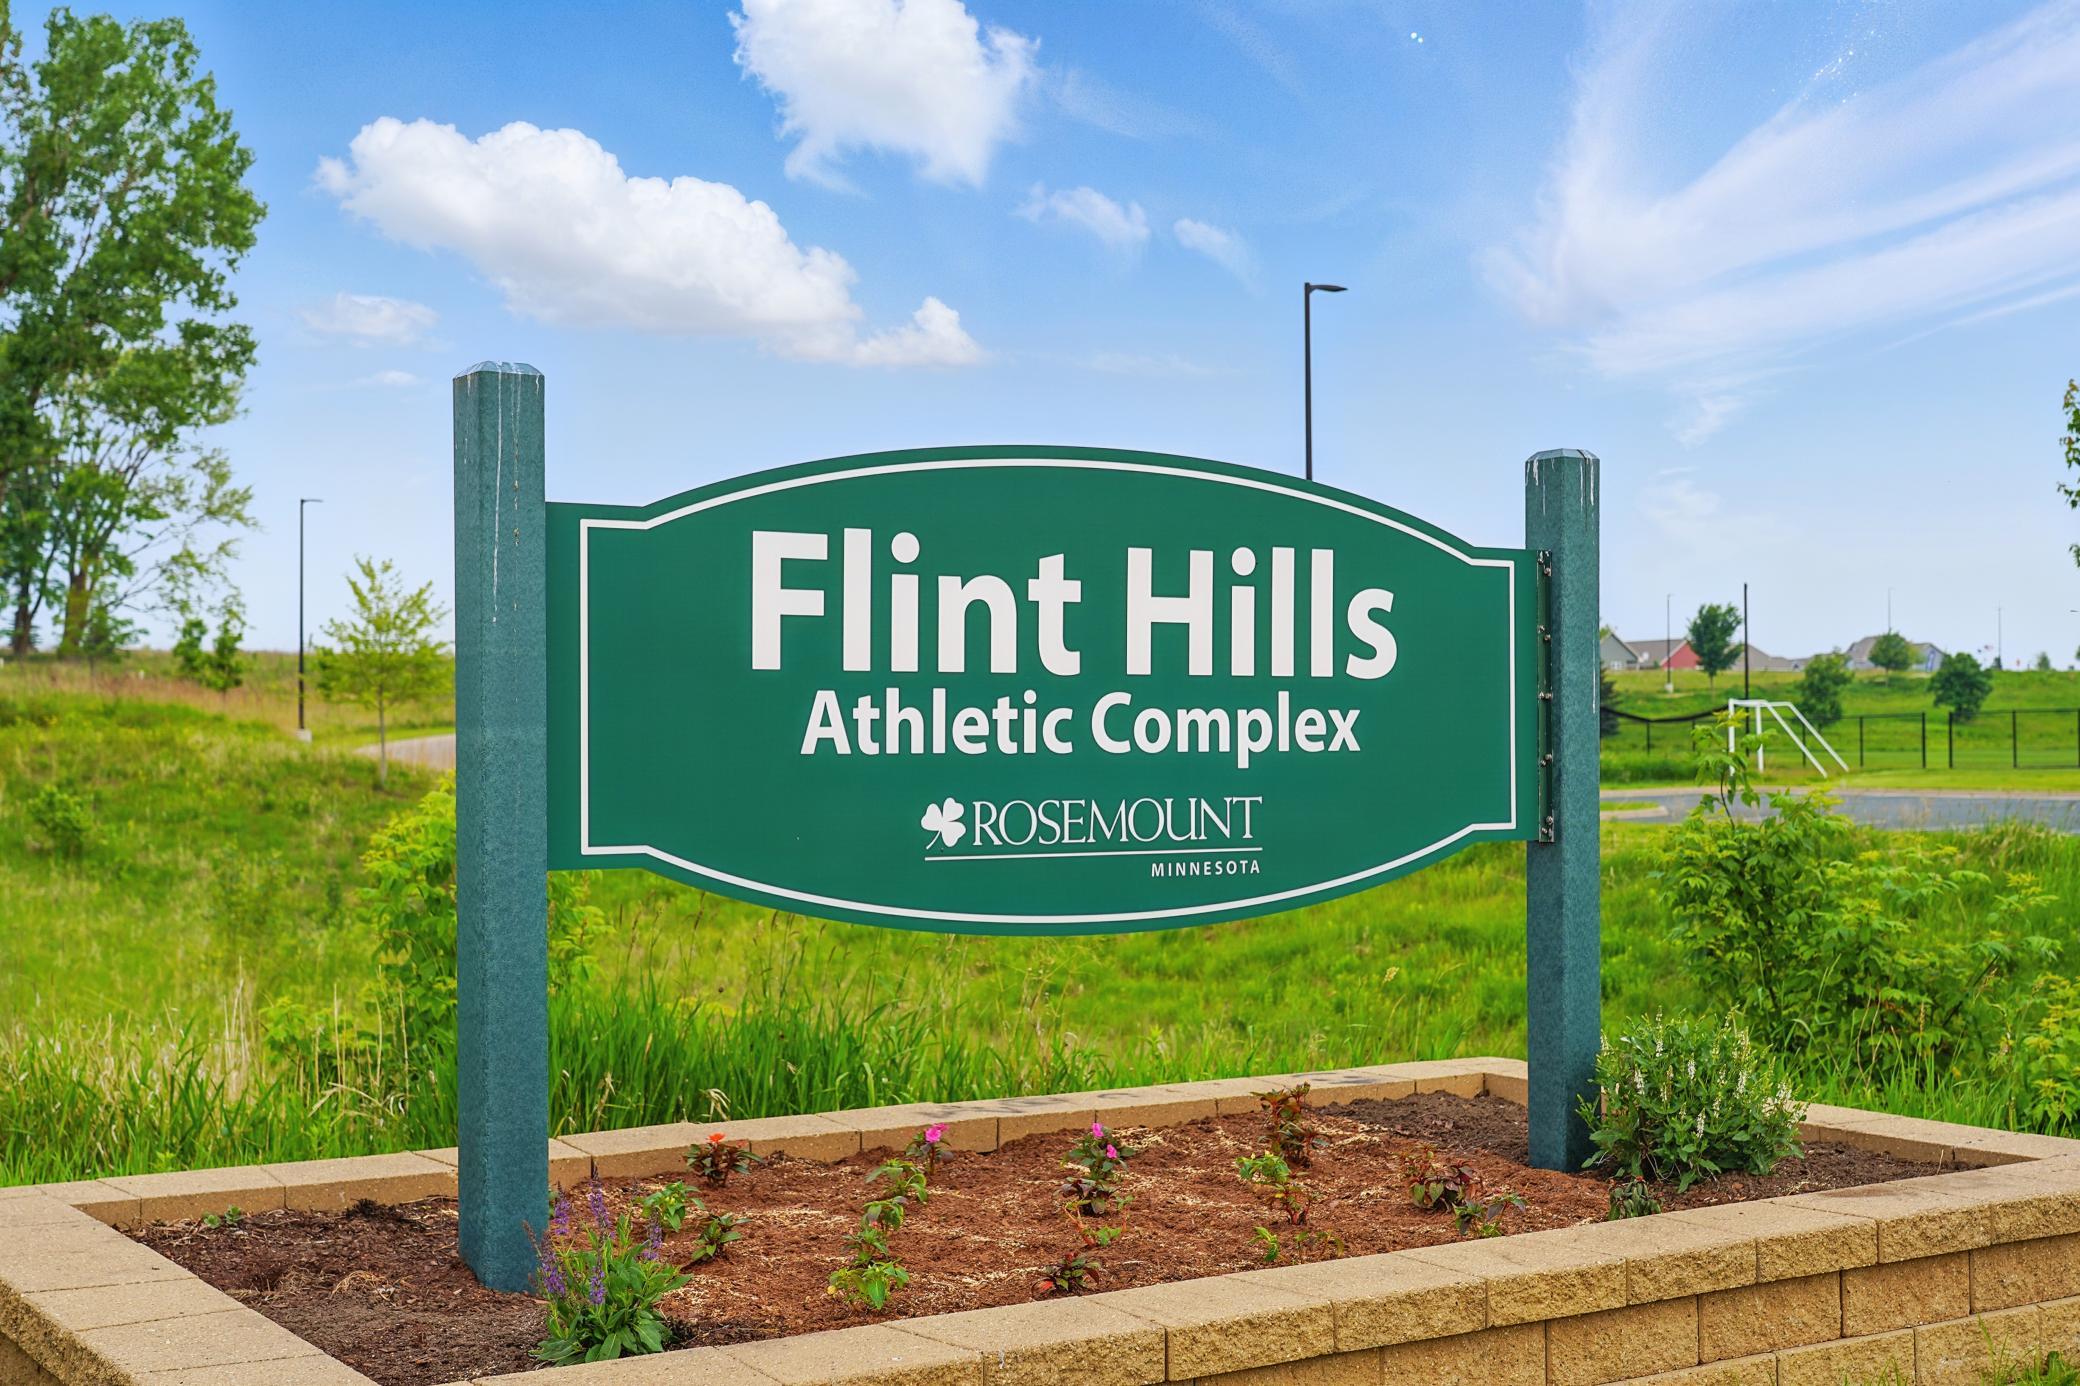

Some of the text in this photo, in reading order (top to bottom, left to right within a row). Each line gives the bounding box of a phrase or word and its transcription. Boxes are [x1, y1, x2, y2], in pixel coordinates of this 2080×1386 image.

[751, 527, 1398, 679] Flint Hills
[800, 687, 1361, 769] Athletic Complex
[972, 796, 1263, 846] ROSEMOUNT
[1151, 859, 1260, 877] MINNESOTA
